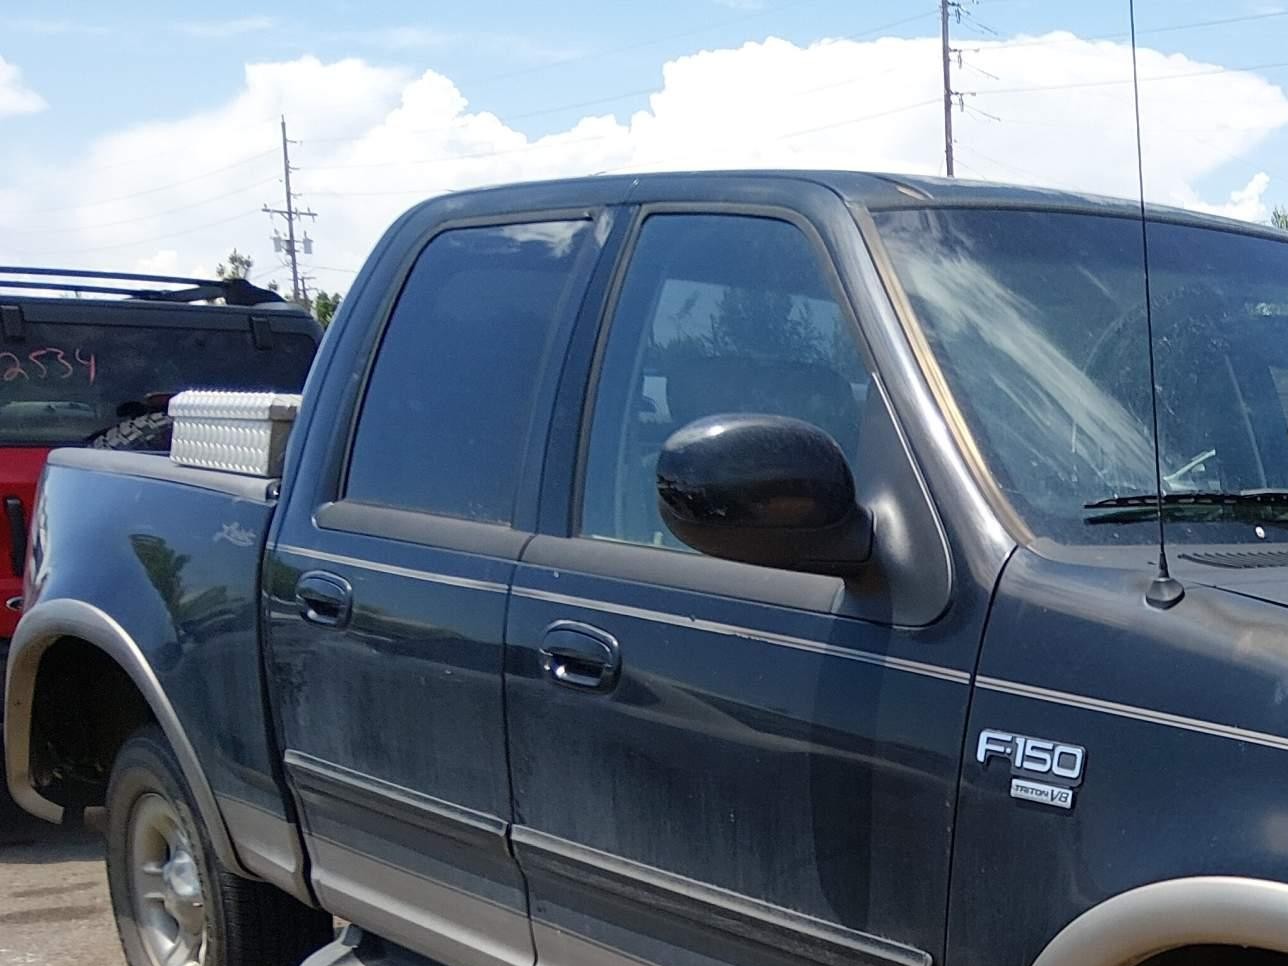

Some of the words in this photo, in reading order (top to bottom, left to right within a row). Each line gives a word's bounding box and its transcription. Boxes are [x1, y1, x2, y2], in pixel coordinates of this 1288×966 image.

[0, 347, 96, 384] 2534
[1014, 784, 1049, 798] TRITON
[1050, 788, 1070, 804] V8
